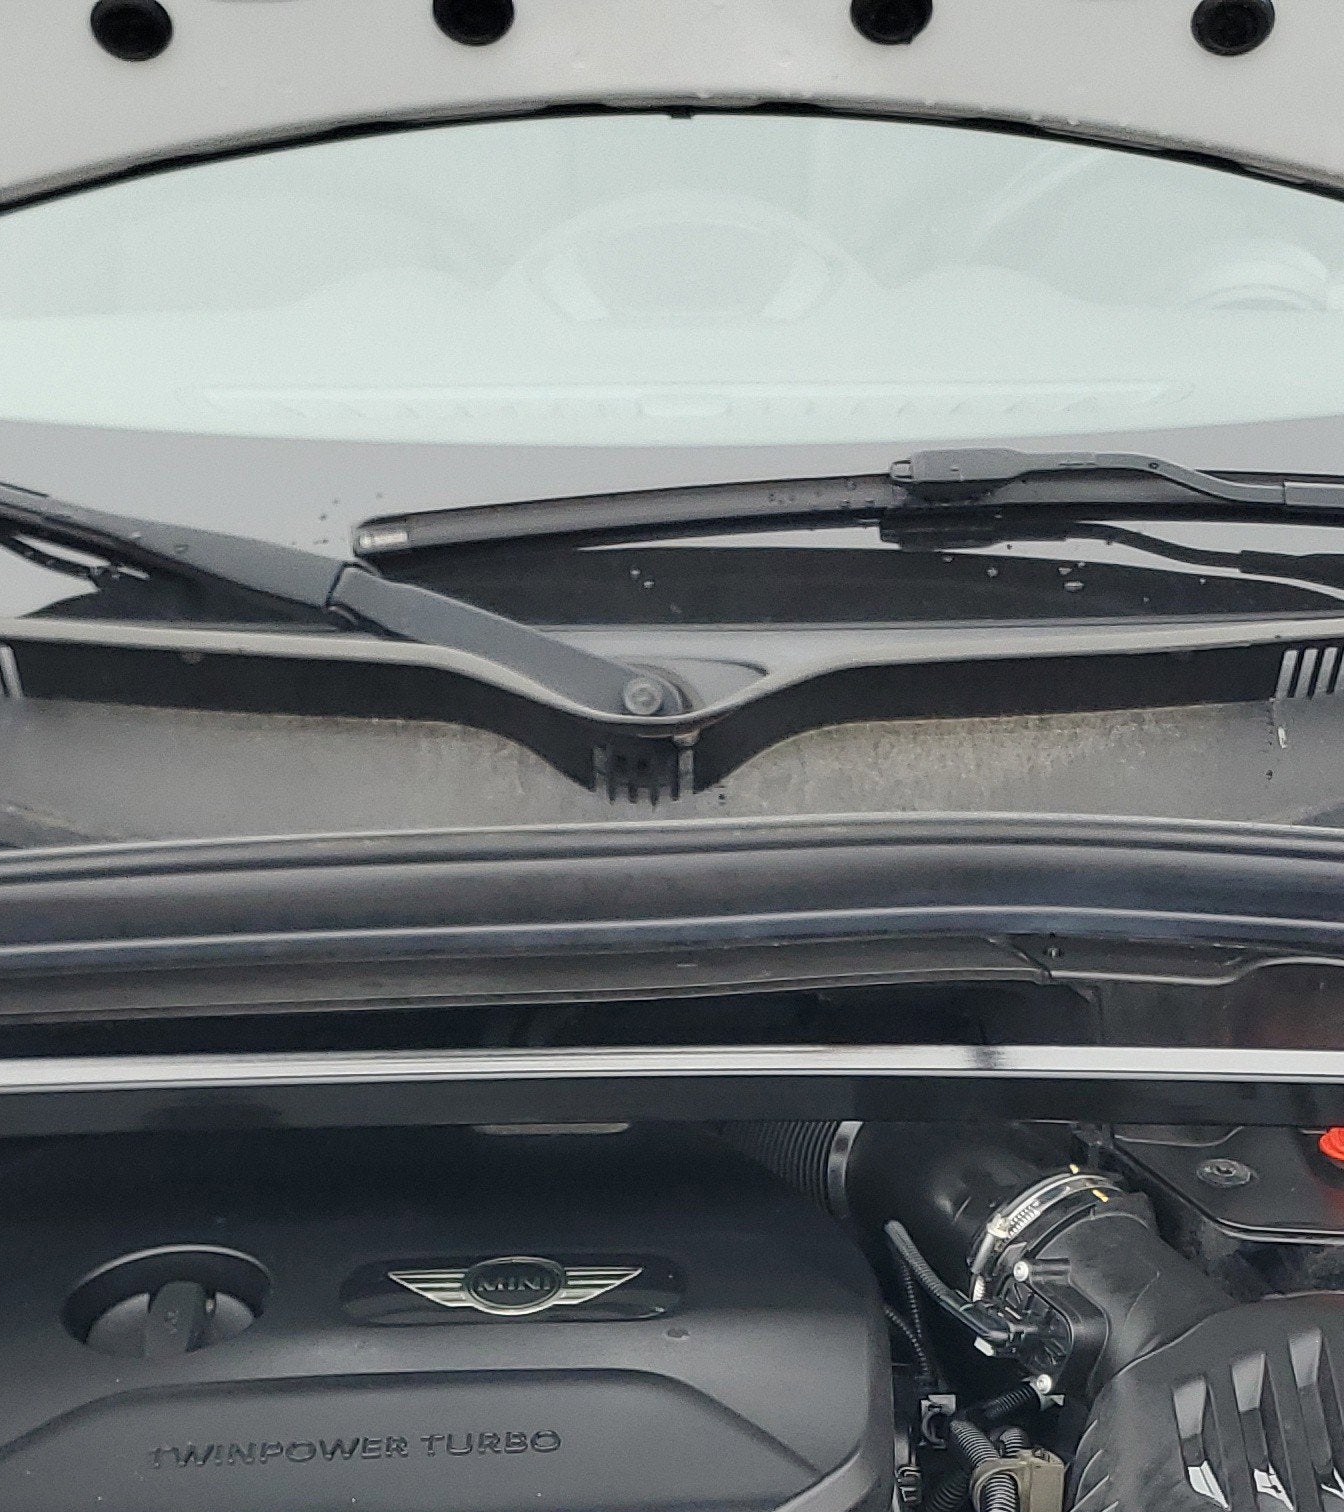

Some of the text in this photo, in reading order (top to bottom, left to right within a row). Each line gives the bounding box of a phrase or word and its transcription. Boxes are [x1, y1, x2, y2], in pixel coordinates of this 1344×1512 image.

[477, 1275, 552, 1291] MINI
[150, 1428, 562, 1468] TWINPOWER TURBO
